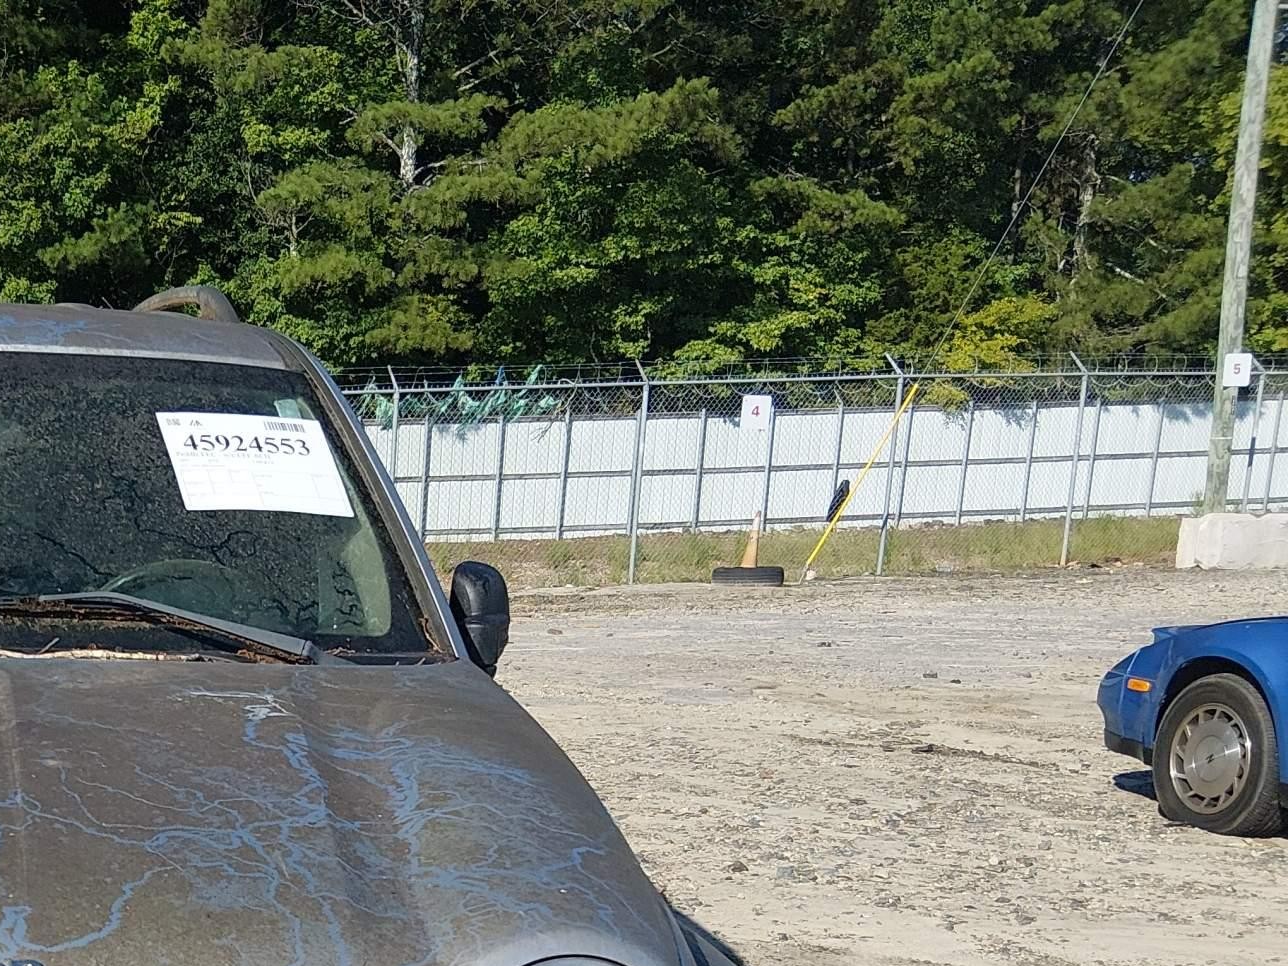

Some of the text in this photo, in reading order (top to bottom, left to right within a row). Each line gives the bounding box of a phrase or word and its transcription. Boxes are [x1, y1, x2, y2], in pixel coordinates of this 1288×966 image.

[1233, 363, 1241, 375] 5
[751, 405, 760, 416] 4
[184, 434, 310, 456] 45924553
